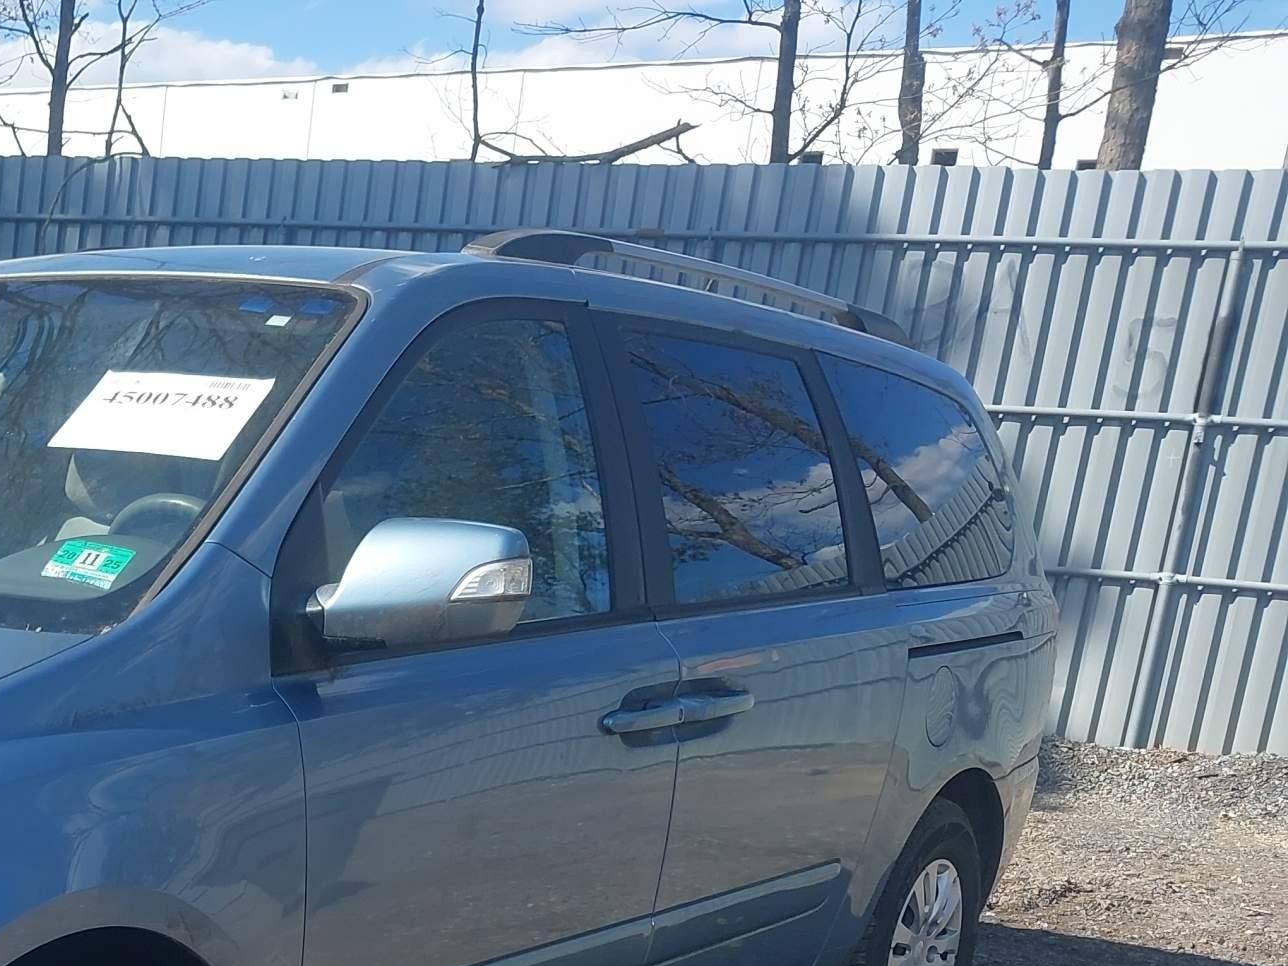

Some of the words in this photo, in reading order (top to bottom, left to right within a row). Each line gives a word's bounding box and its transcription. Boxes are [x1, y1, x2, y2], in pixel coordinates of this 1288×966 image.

[103, 391, 239, 409] 45007488
[57, 549, 77, 560] 20
[78, 552, 101, 567] 11
[102, 559, 122, 570] 25
